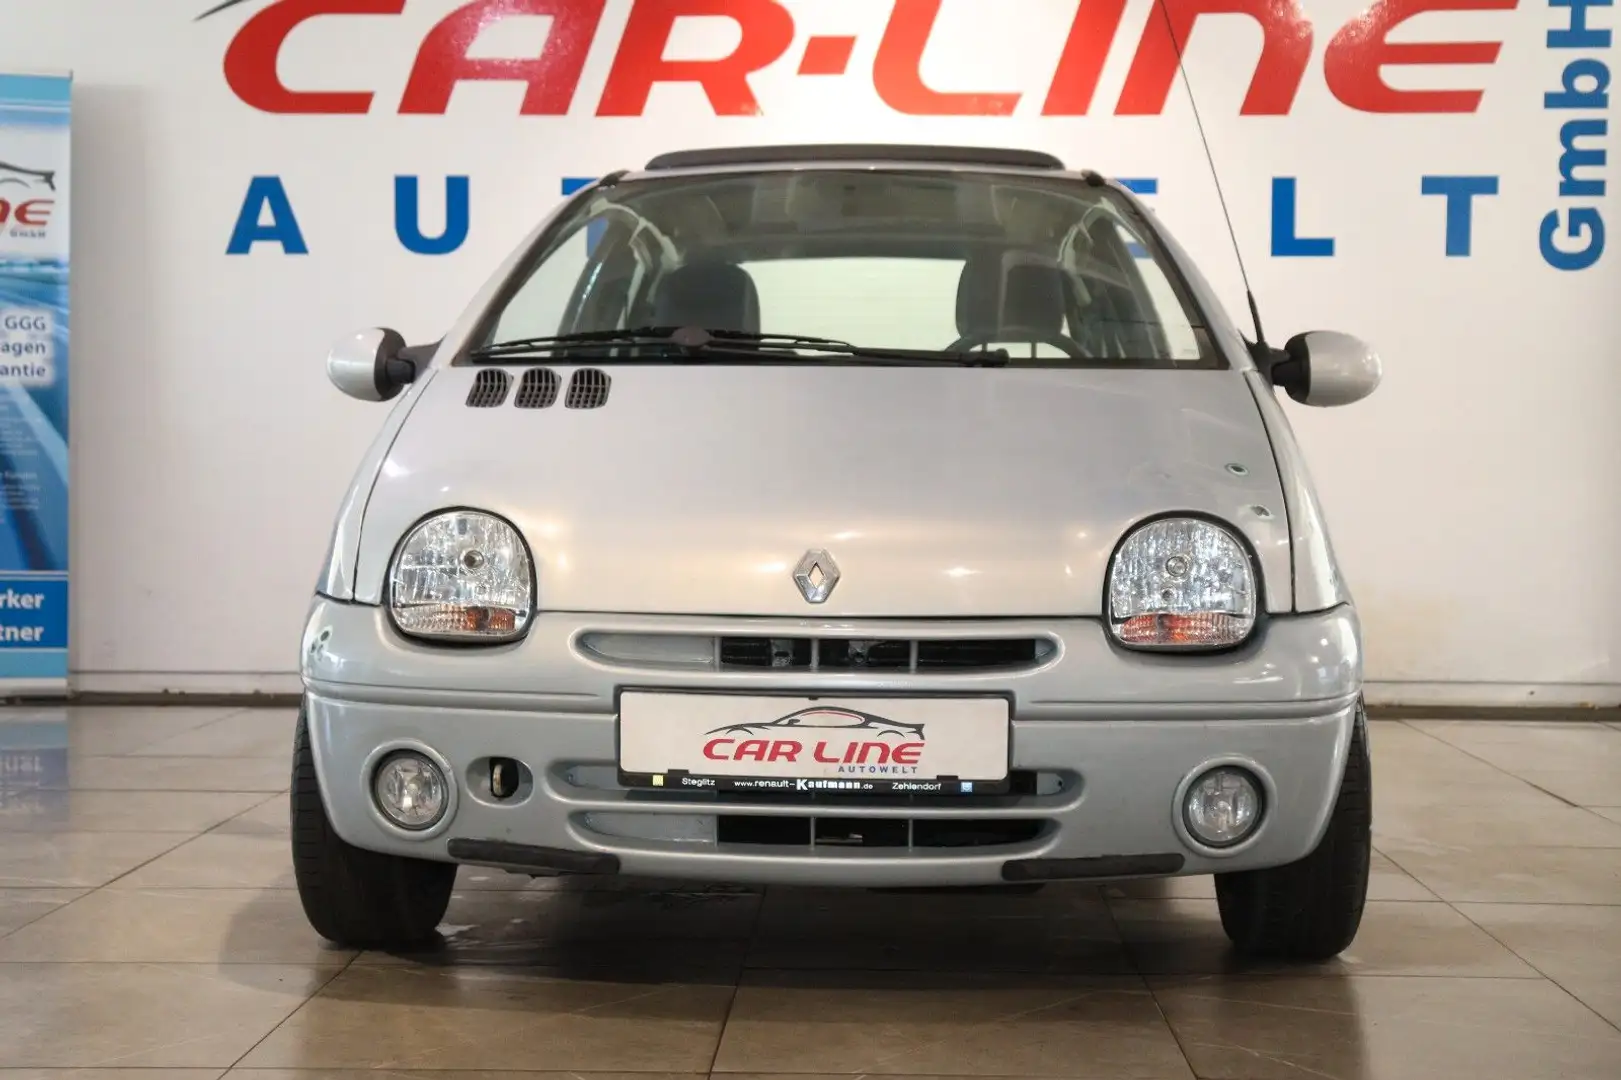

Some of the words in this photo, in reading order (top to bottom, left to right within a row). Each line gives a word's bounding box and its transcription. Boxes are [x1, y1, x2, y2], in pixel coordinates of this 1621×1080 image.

[224, 0, 1519, 116] CAR-LINE
[1539, 0, 1613, 271] GmbH
[5, 315, 46, 331] GGG
[702, 738, 803, 762] CAR
[813, 741, 925, 765] LINE
[837, 766, 918, 774] AUTOWELT
[682, 778, 716, 787] Steglitz
[892, 782, 942, 791] Zehlendorf
